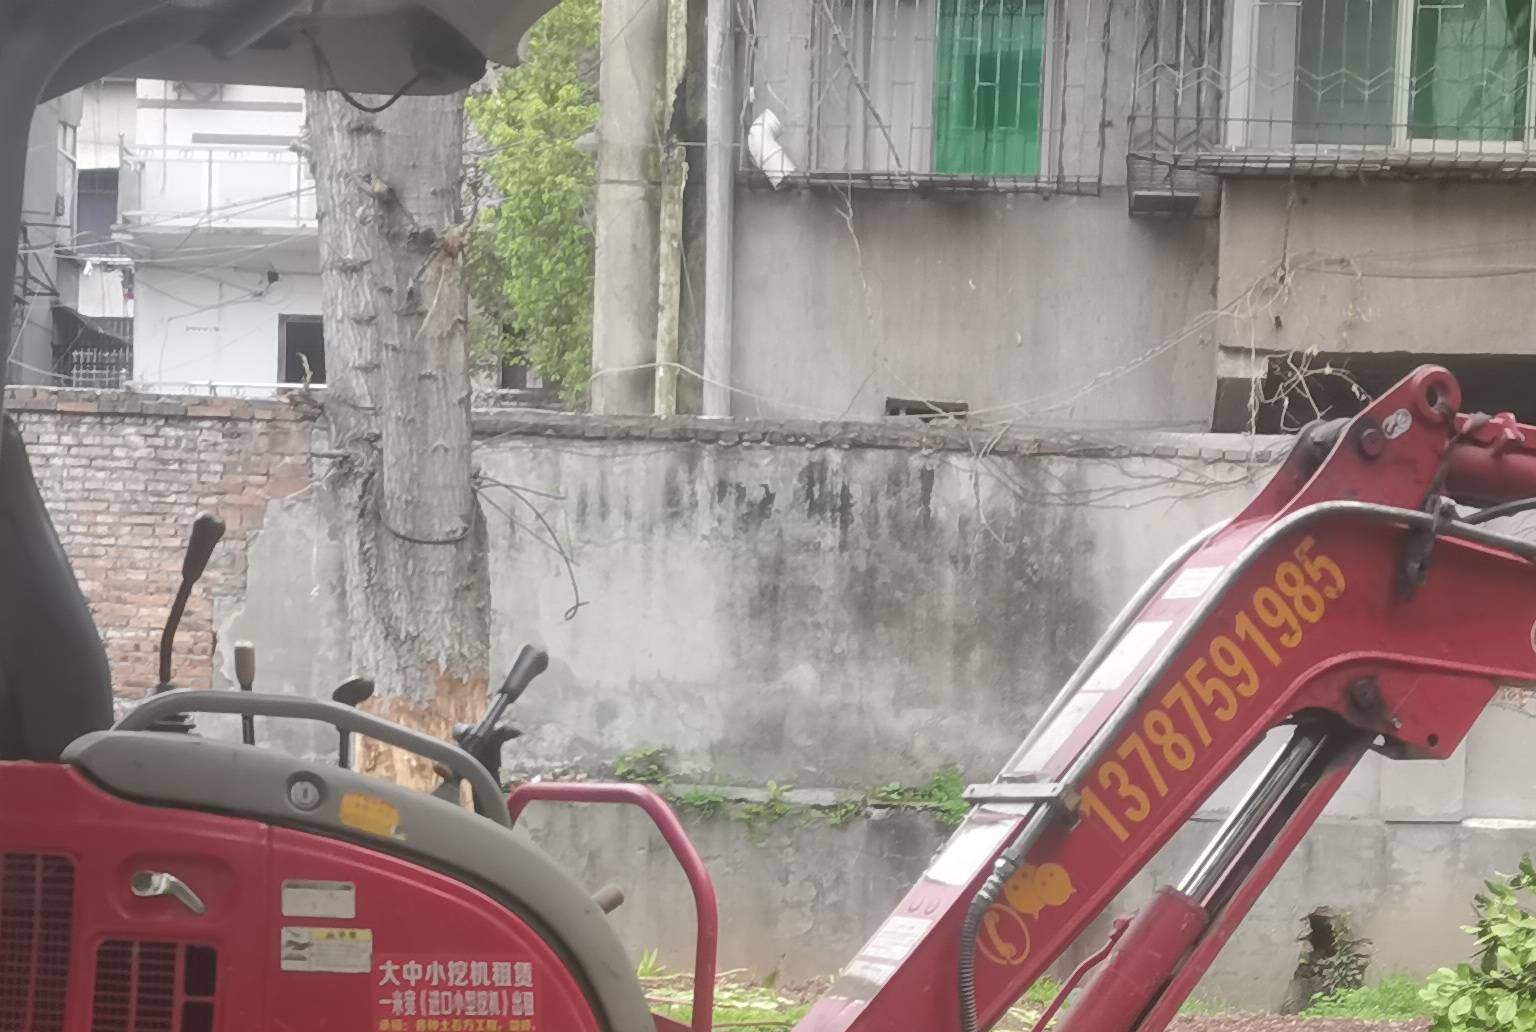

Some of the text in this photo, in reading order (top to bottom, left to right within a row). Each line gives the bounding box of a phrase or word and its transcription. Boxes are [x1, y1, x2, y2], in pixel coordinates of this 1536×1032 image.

[1079, 536, 1345, 843] 13787591985
[379, 960, 533, 988] 大中小挖机租赁
